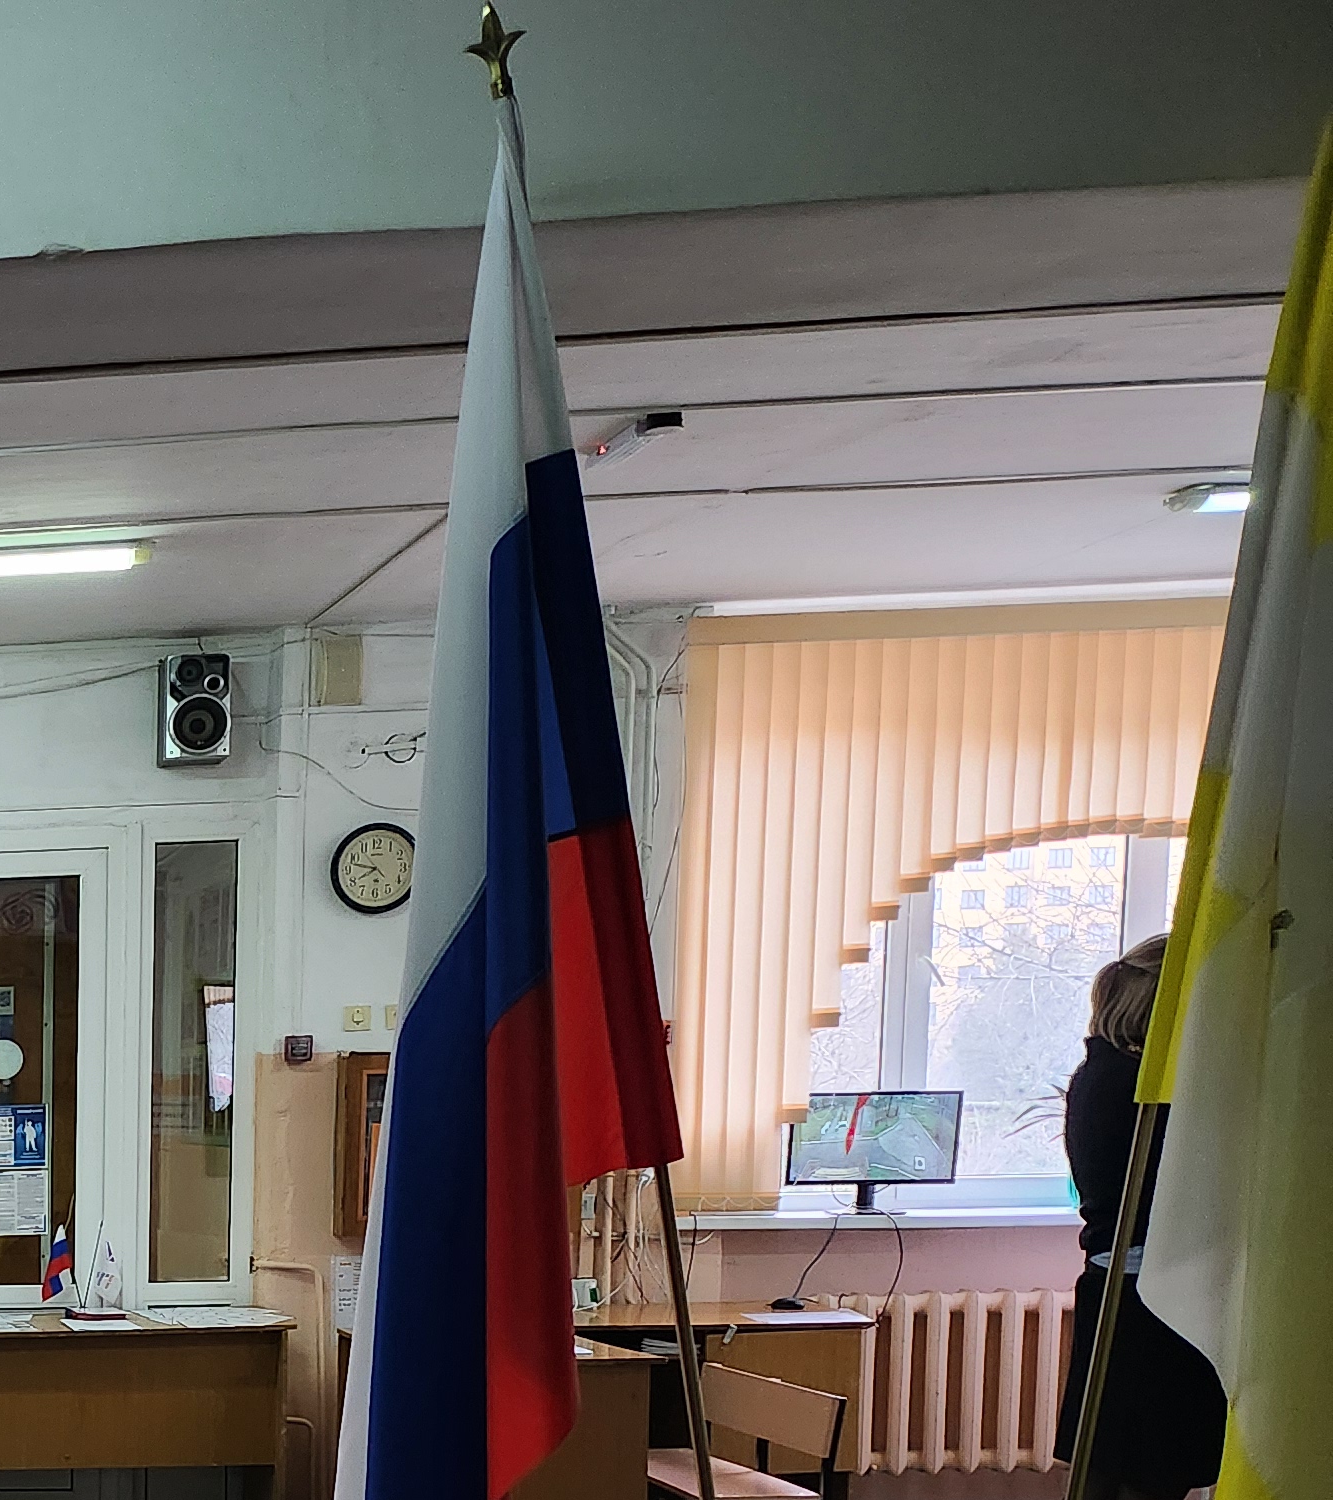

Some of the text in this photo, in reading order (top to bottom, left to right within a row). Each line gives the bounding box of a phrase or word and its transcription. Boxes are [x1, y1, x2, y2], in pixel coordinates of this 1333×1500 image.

[372, 838, 383, 850] 12
[389, 841, 392, 852] 1
[349, 852, 360, 865] 10
[397, 850, 403, 860] 2
[345, 866, 351, 875] 9
[399, 862, 407, 873] 3
[349, 877, 356, 887] 8
[359, 885, 365, 896] 7
[372, 888, 378, 898] 6
[385, 884, 391, 894] 5
